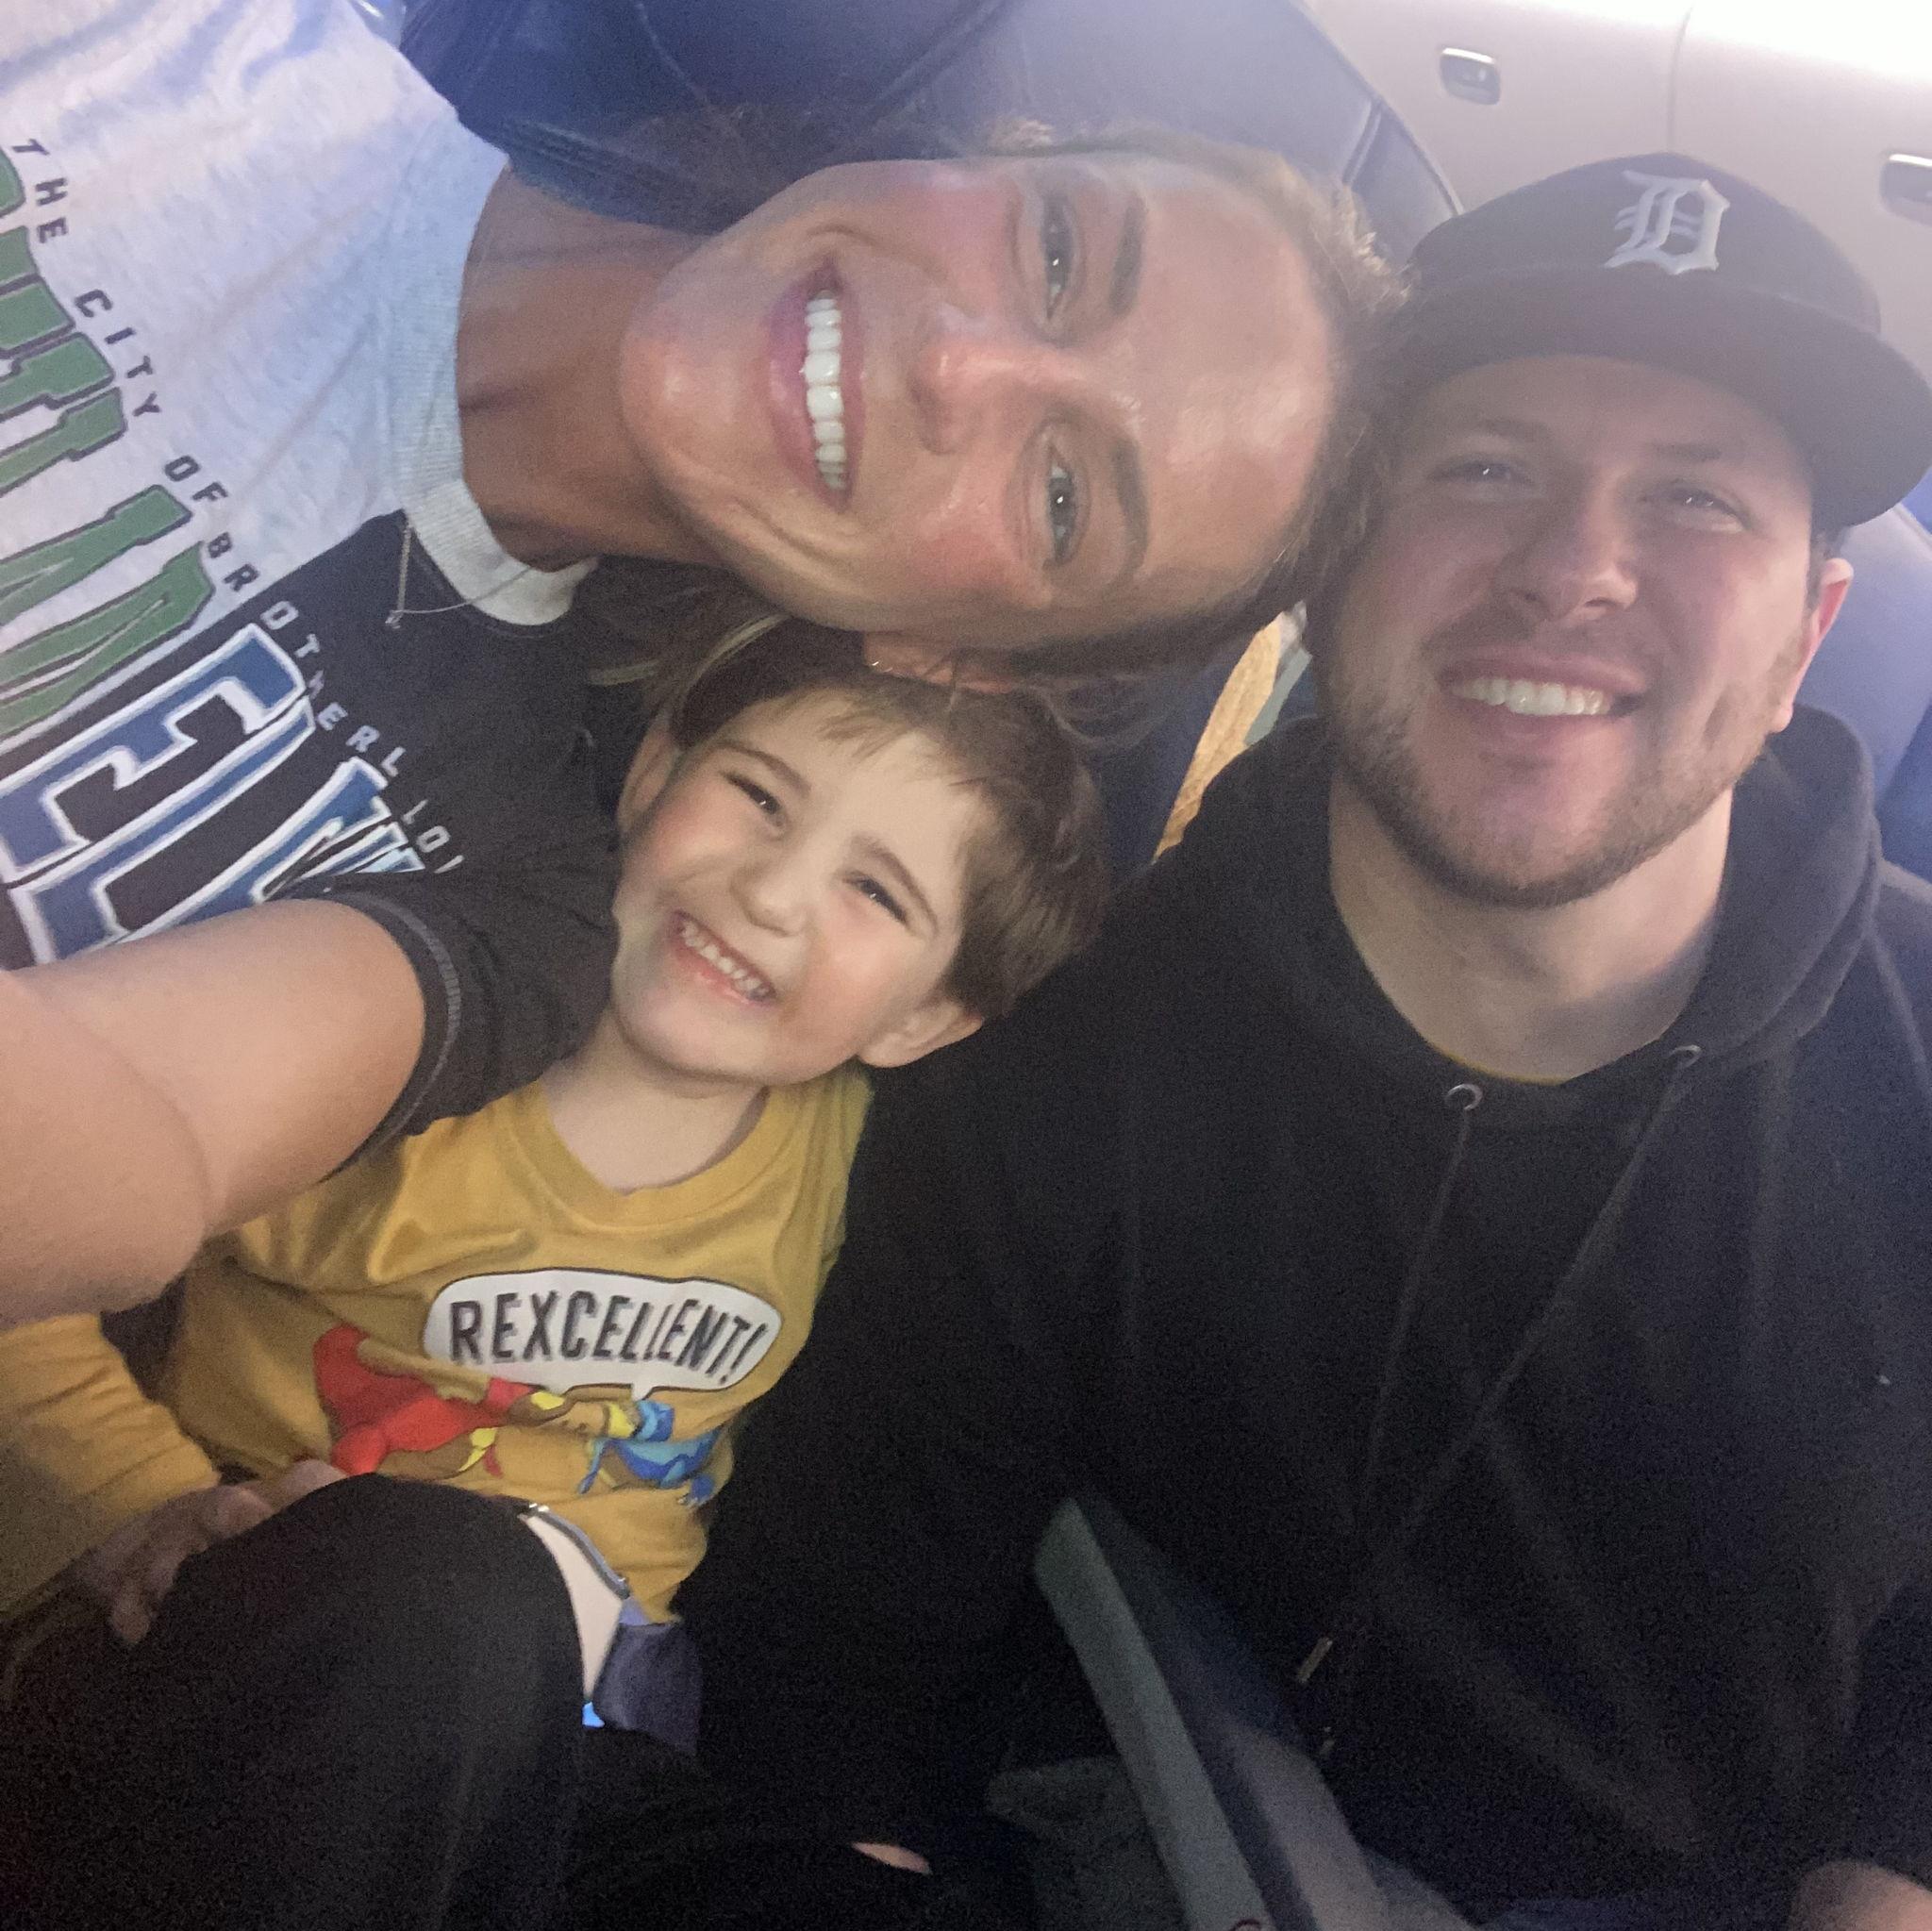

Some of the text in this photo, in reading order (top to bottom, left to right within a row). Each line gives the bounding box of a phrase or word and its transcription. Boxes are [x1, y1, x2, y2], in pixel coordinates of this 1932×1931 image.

[1603, 170, 1731, 275] D
[11, 138, 465, 874] THE CITY OF BROTHERL LO
[448, 1289, 771, 1386] REXCELLENT!
